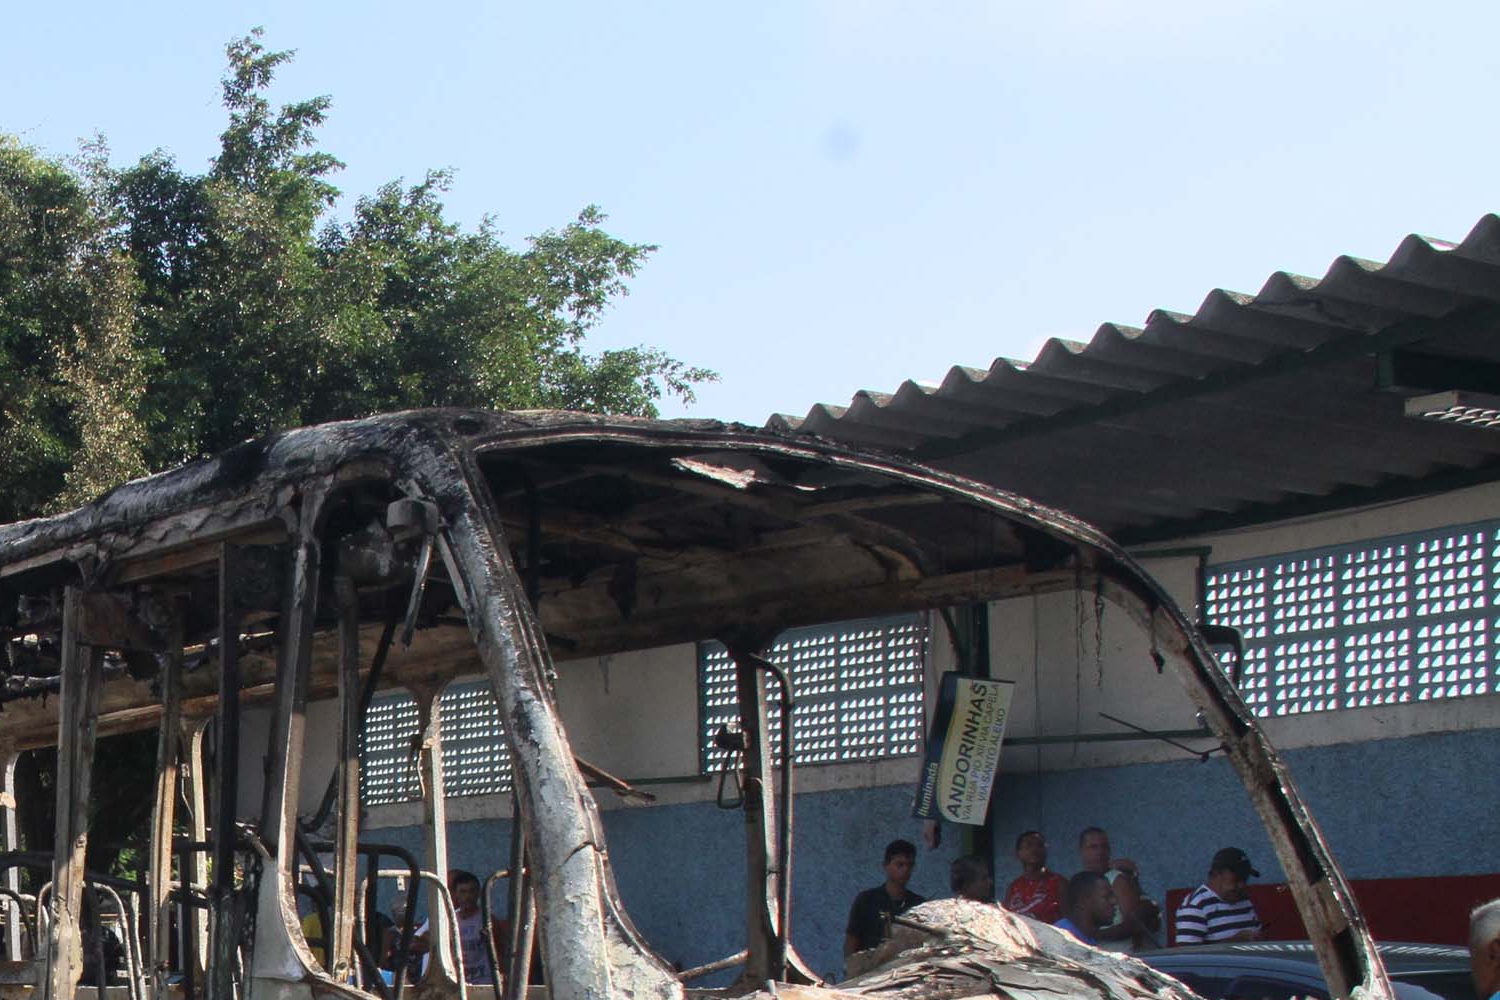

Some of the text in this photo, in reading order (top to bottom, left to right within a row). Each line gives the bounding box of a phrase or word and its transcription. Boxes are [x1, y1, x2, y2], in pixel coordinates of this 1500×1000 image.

[983, 683, 999, 723] CAPELA
[978, 725, 989, 742] VIA
[947, 683, 987, 818] ANDORINHAS
[976, 707, 1005, 801] VIA SANTO ALEIXO
[970, 759, 981, 778] PIO
[965, 779, 977, 801] RUA
[961, 804, 973, 820] VIA
